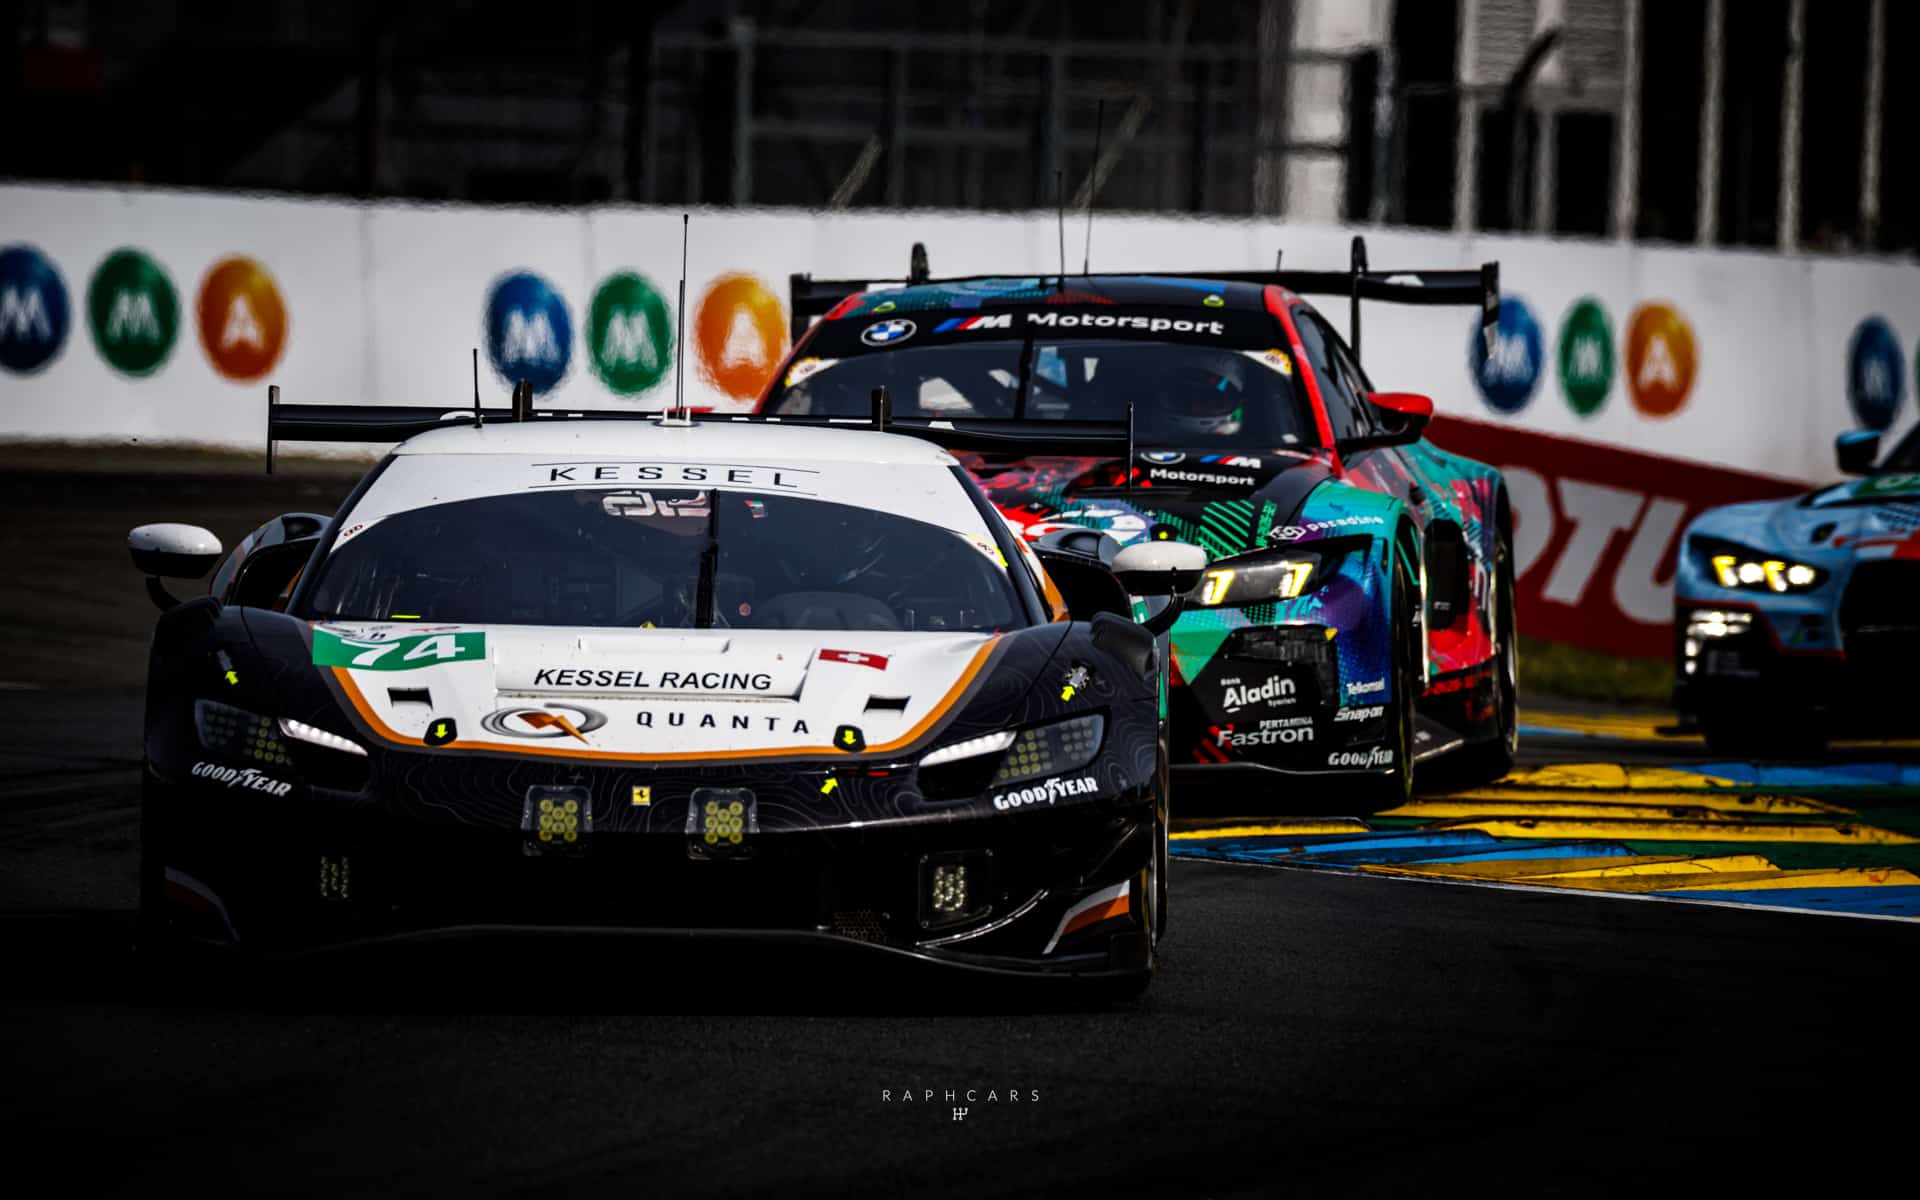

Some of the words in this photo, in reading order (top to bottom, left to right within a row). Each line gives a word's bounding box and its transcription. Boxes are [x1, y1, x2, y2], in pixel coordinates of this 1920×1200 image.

[1027, 313, 1224, 334] Motorsport
[550, 466, 798, 489] KESSEL
[1150, 469, 1255, 485] Motorsport
[1499, 466, 1688, 624] OTU
[341, 634, 466, 666] 74
[534, 669, 650, 688] KESSEL
[660, 672, 772, 690] RACING
[1223, 675, 1296, 708] Aladin
[637, 711, 809, 734] QUANTA
[1334, 706, 1384, 722] Snap-on
[1217, 727, 1314, 747] Fastron
[191, 760, 293, 798] GOODYEAR
[993, 777, 1098, 811] GOODYEAR
